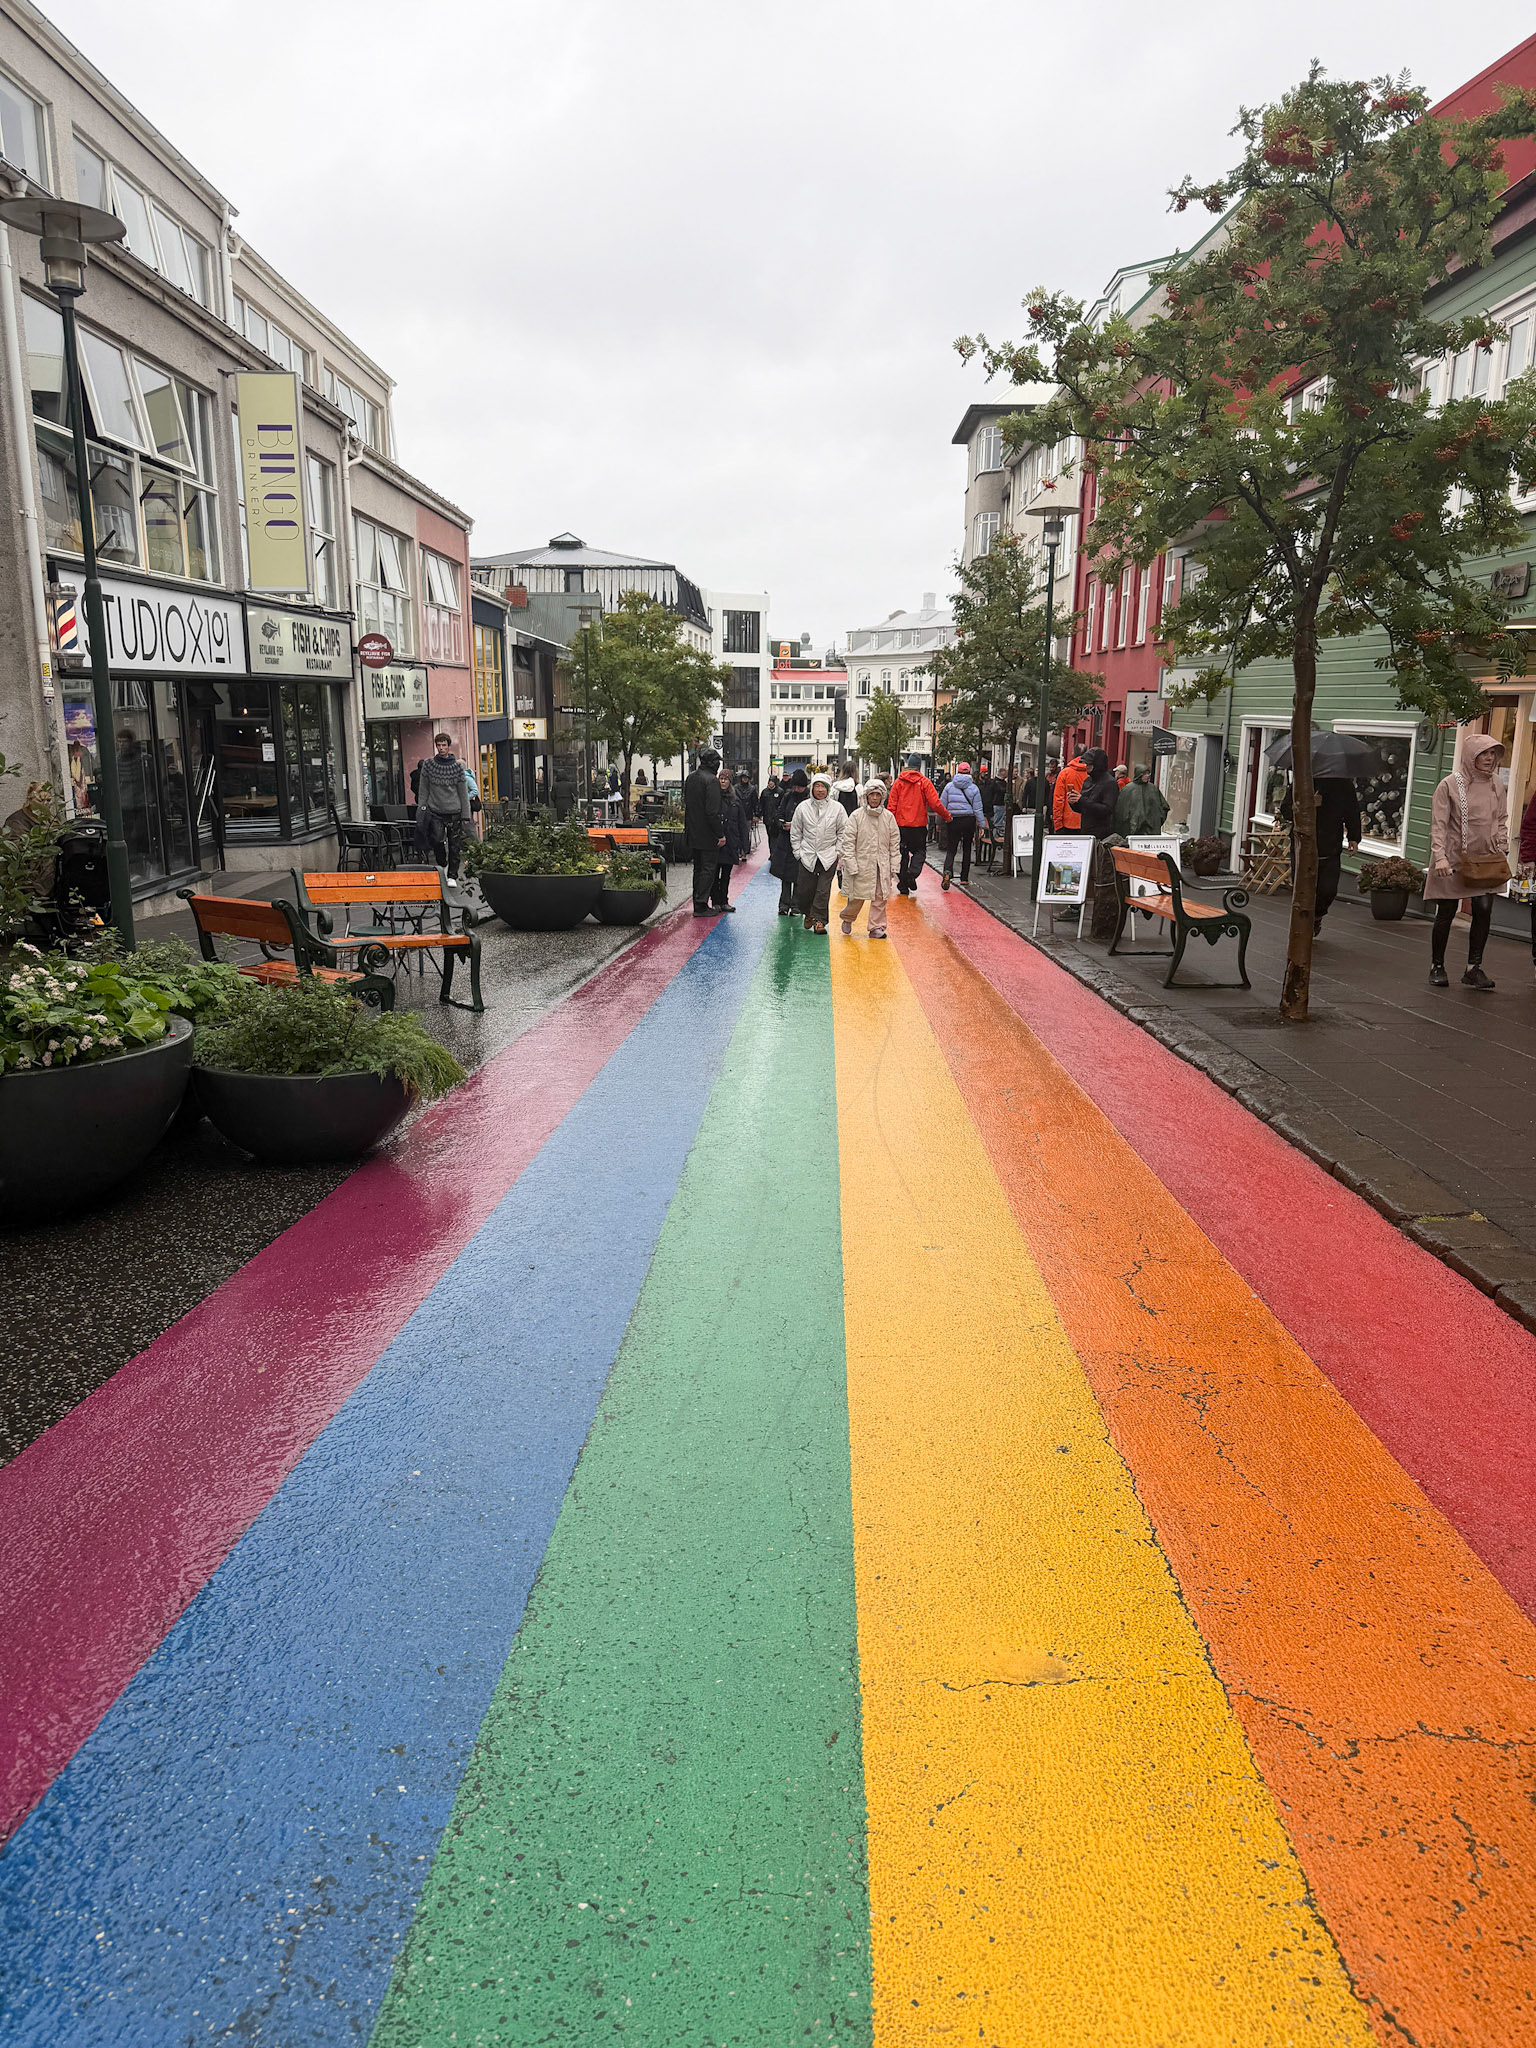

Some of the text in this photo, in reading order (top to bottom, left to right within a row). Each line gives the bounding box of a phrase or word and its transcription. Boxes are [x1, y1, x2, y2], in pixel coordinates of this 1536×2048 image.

[246, 438, 261, 528] DRINKERY
[257, 424, 300, 541] BINGO
[291, 621, 341, 657] FISH & CHIPS
[371, 673, 406, 699] FISH & CHIPS
